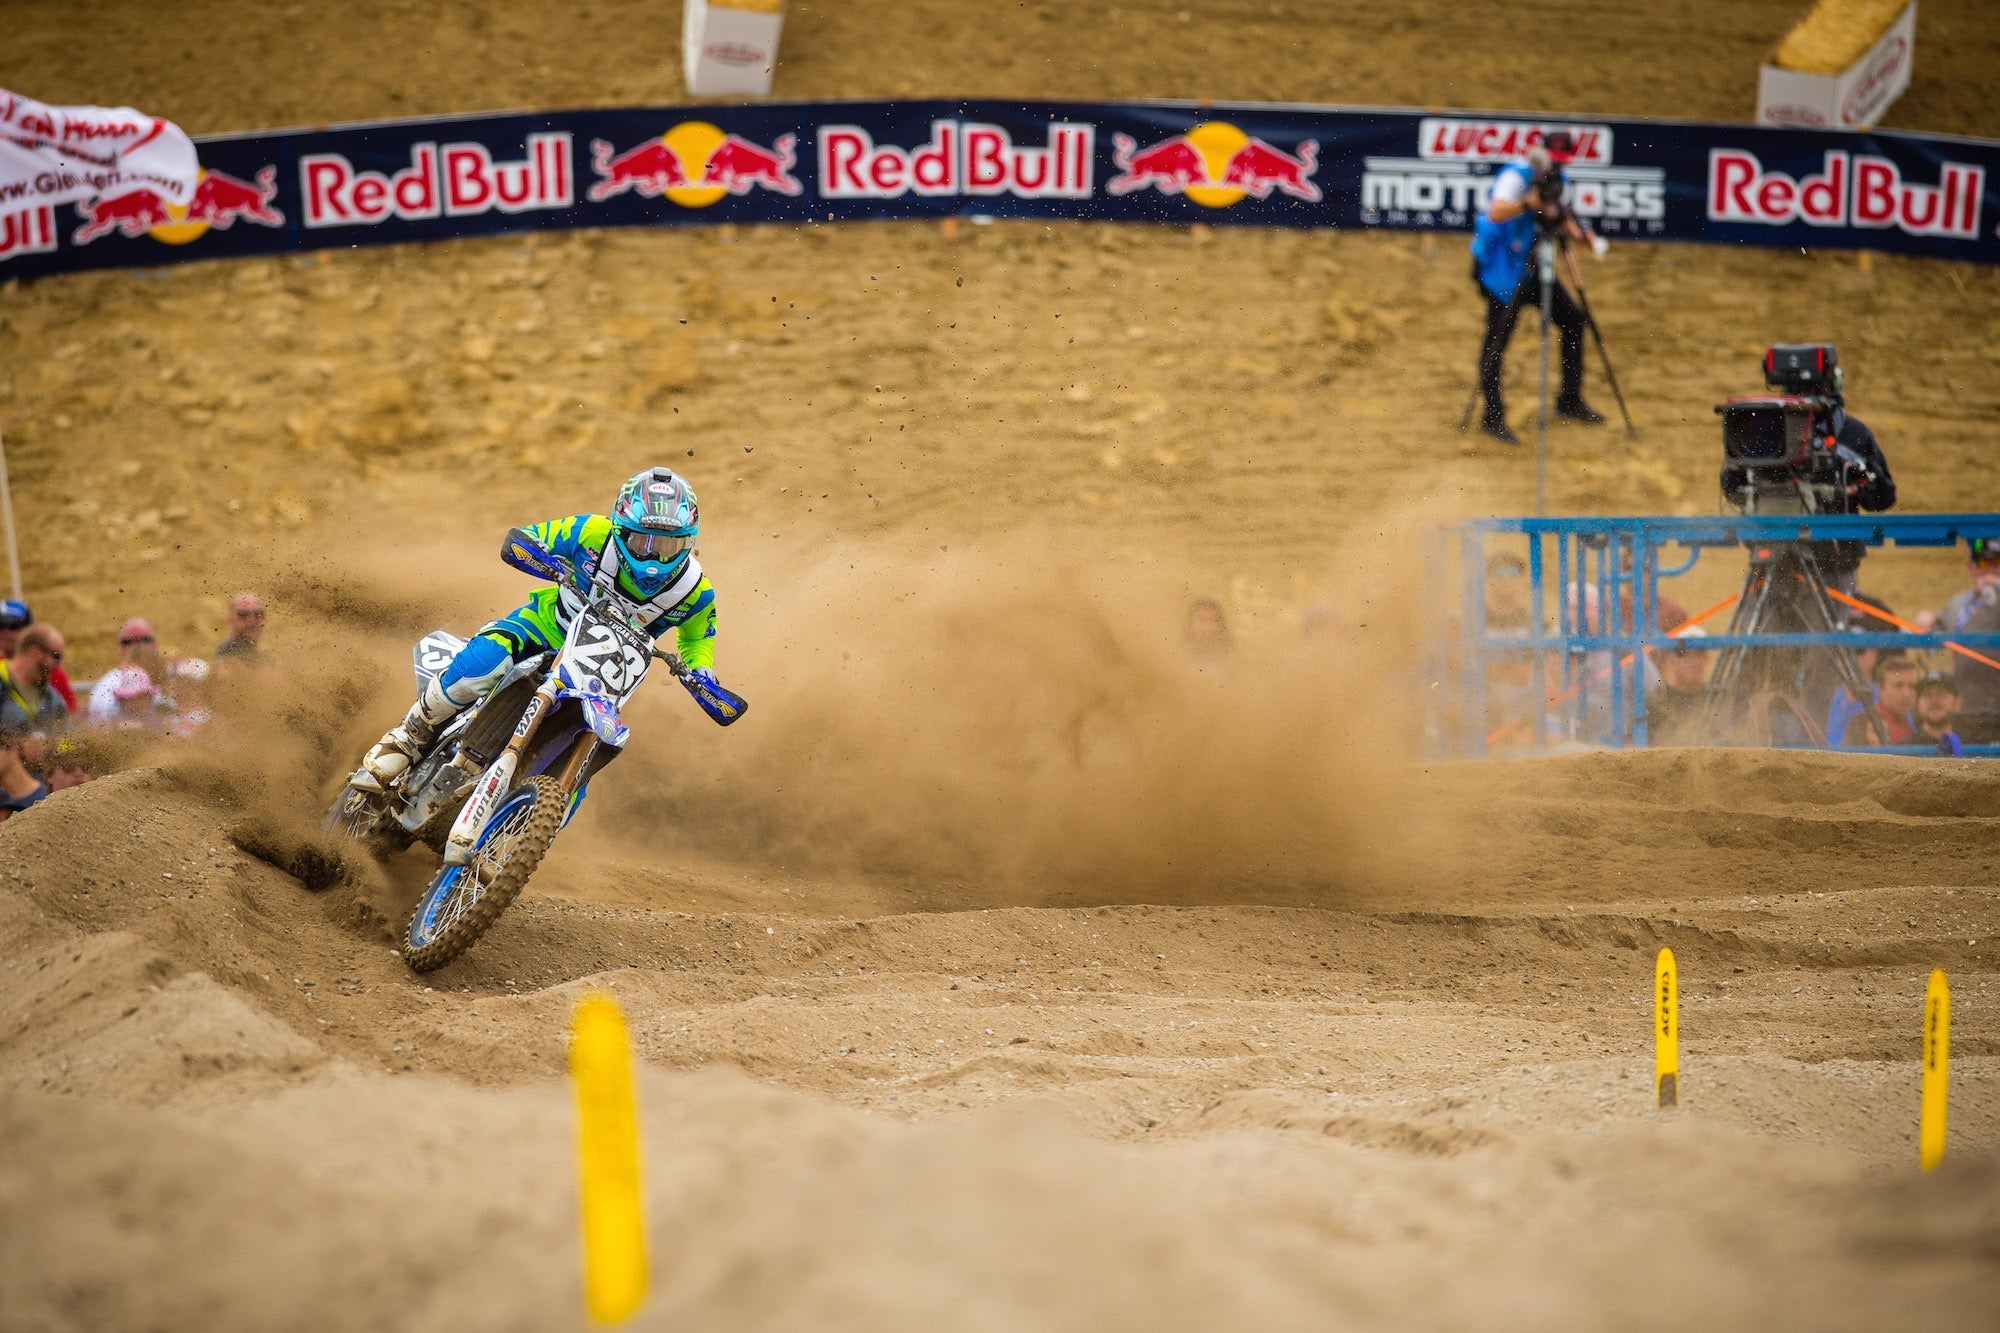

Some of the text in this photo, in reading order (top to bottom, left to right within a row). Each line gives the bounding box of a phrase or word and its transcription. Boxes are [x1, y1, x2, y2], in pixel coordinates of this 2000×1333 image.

[303, 133, 572, 226] Red Bull
[820, 121, 1093, 198] Red Bull
[1709, 149, 1984, 239] Red Bull
[0, 206, 52, 252] ull
[574, 624, 646, 692] 23
[628, 635, 640, 648] OIL
[473, 764, 505, 828] DLOP
